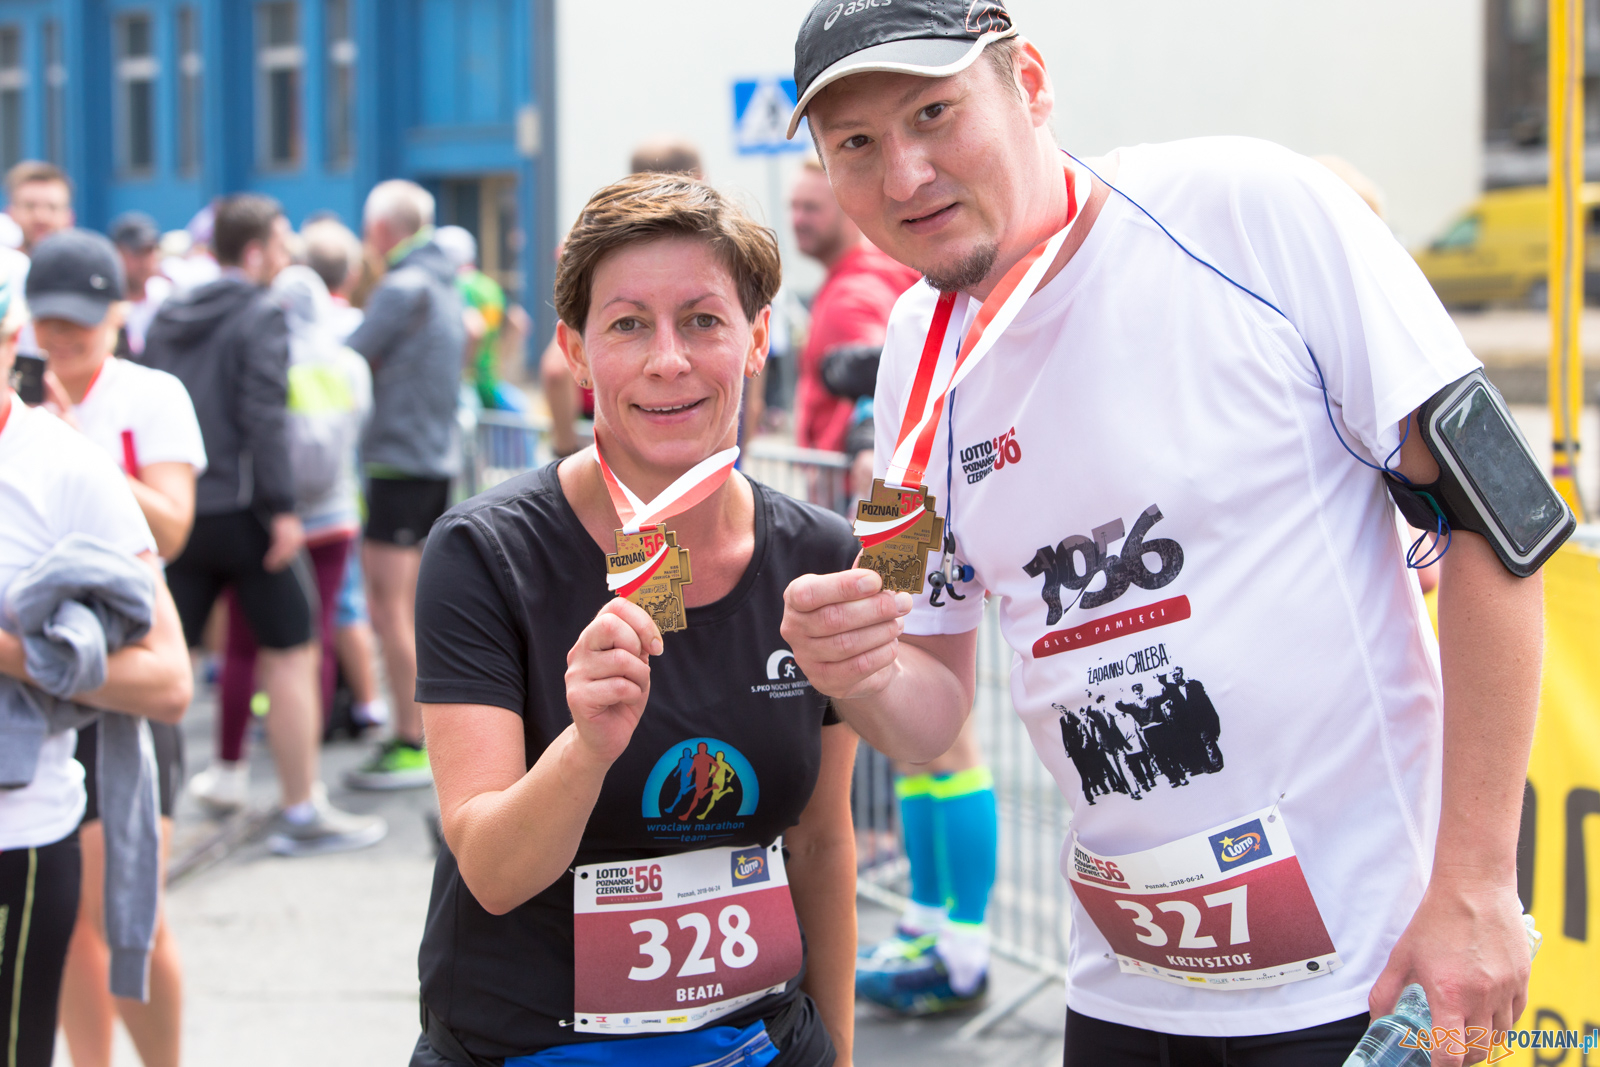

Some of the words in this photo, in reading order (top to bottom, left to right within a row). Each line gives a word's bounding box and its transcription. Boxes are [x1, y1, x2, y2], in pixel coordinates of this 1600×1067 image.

[960, 440, 992, 464] LOTTO
[862, 504, 899, 517] POZNAŃ
[610, 550, 646, 568] POZNAŃ
[1022, 503, 1184, 626] 1956
[1044, 632, 1082, 648] BIEG
[1095, 608, 1165, 634] PAMIĘCI
[1087, 660, 1124, 686] ŻĄDAMY
[1126, 643, 1169, 675] CHLEBA
[694, 821, 744, 831] marathon
[1227, 836, 1253, 856] LOTTO
[596, 868, 628, 879] LOTTO
[740, 860, 758, 875] LOTTO
[596, 878, 634, 887] POZNAŃSKI
[1170, 874, 1204, 887] 2018-06-24
[596, 886, 634, 895] CZERWIEC
[1114, 884, 1250, 949] 327
[628, 904, 758, 981] 328
[1166, 952, 1252, 968] KRZYSZTOF
[676, 983, 724, 1002] BEATA
